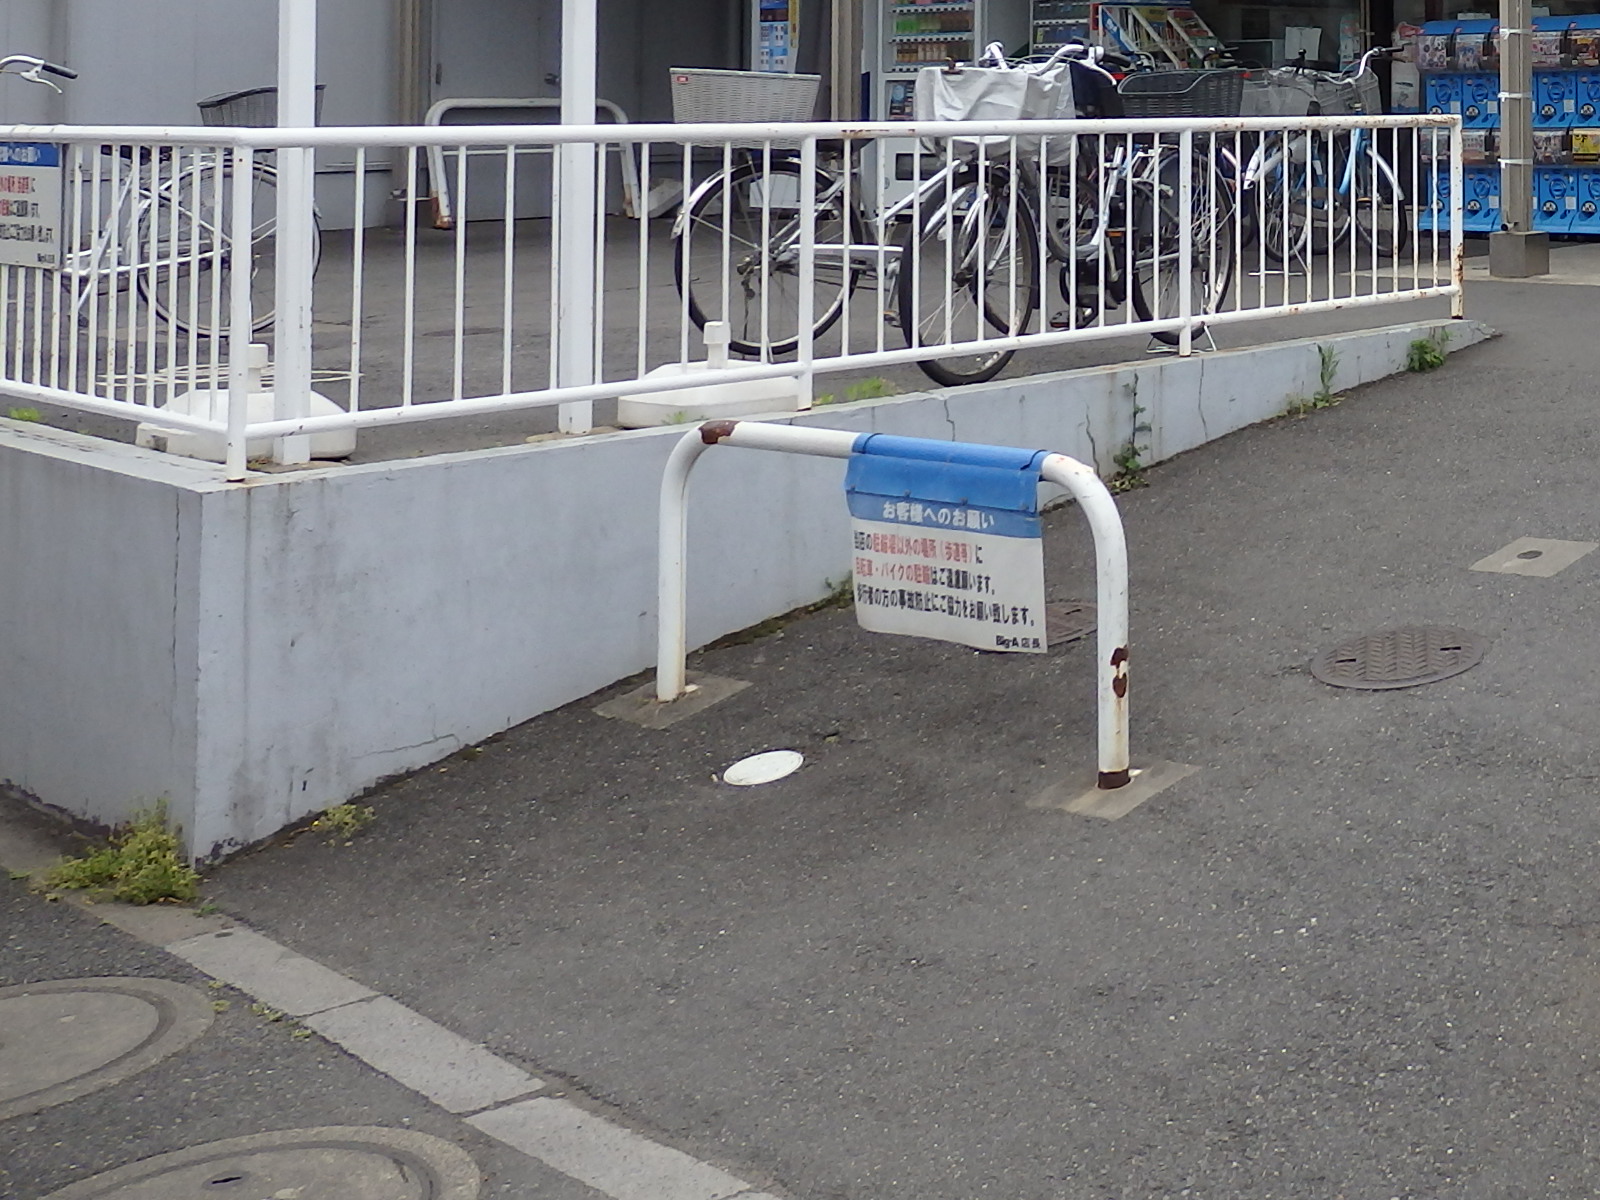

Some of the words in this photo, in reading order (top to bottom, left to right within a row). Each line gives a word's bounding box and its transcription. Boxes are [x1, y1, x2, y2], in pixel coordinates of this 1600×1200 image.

[882, 501, 995, 530] お客様へのお願い
